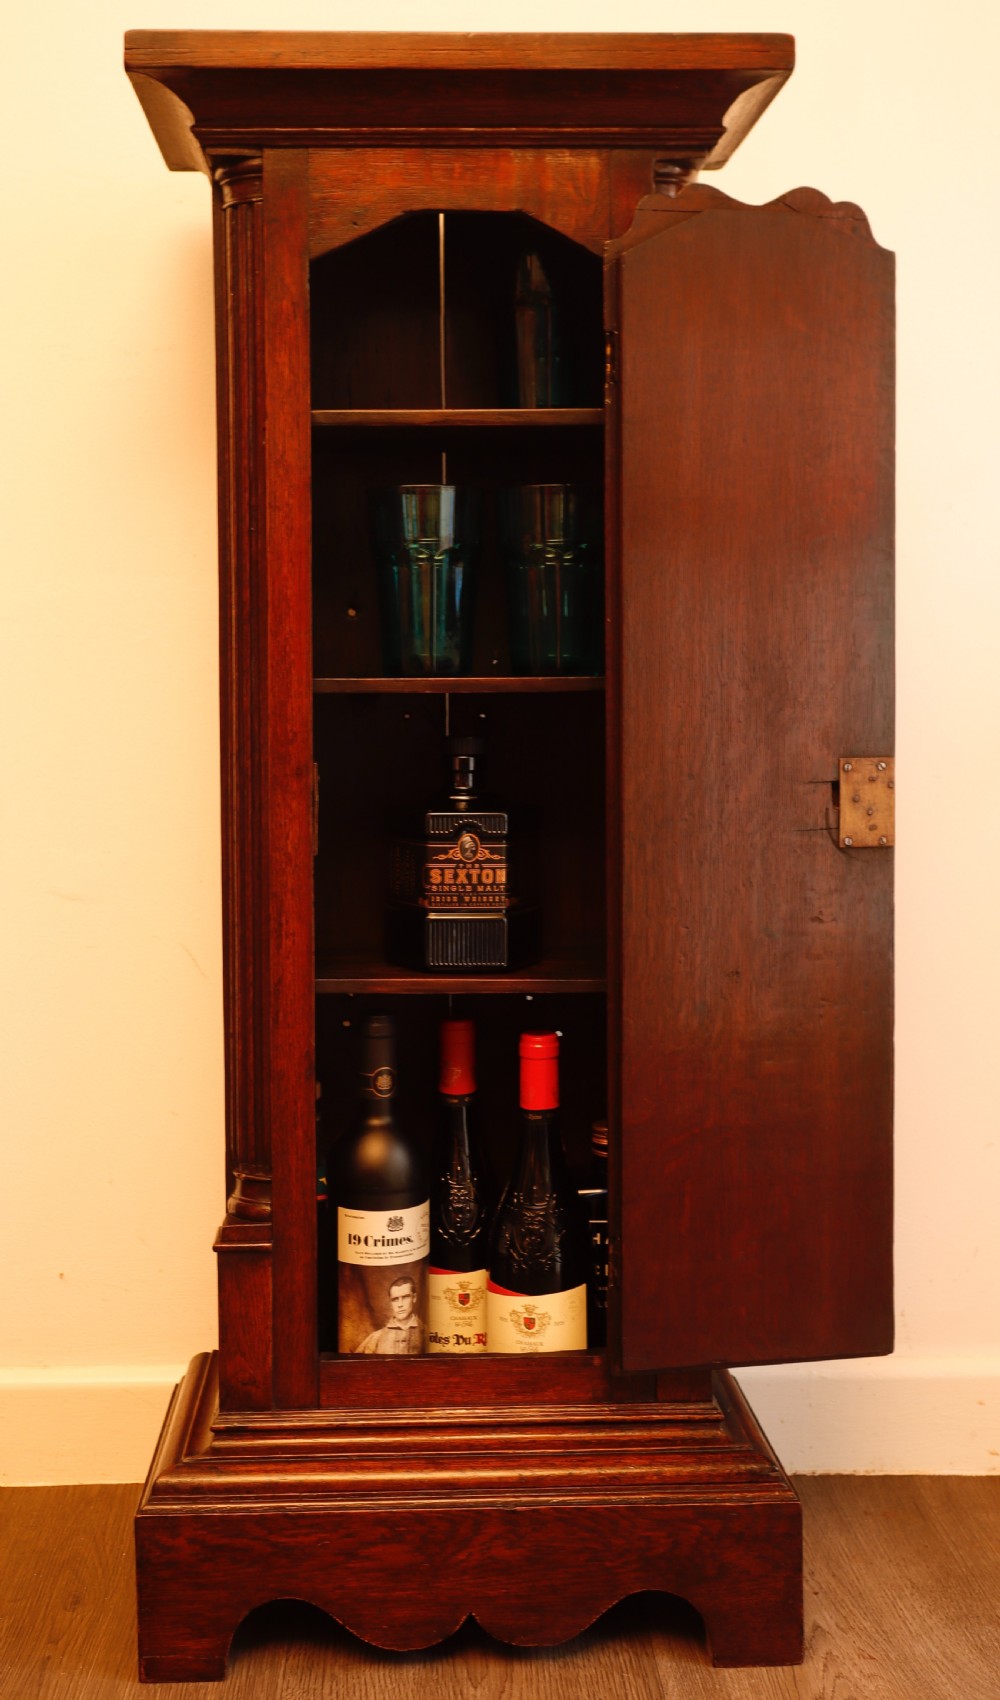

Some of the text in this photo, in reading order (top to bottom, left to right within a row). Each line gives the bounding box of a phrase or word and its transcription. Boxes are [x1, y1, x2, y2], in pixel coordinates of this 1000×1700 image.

[430, 868, 506, 884] SEXTON
[347, 1233, 361, 1246] 19
[452, 1333, 471, 1346] Du
